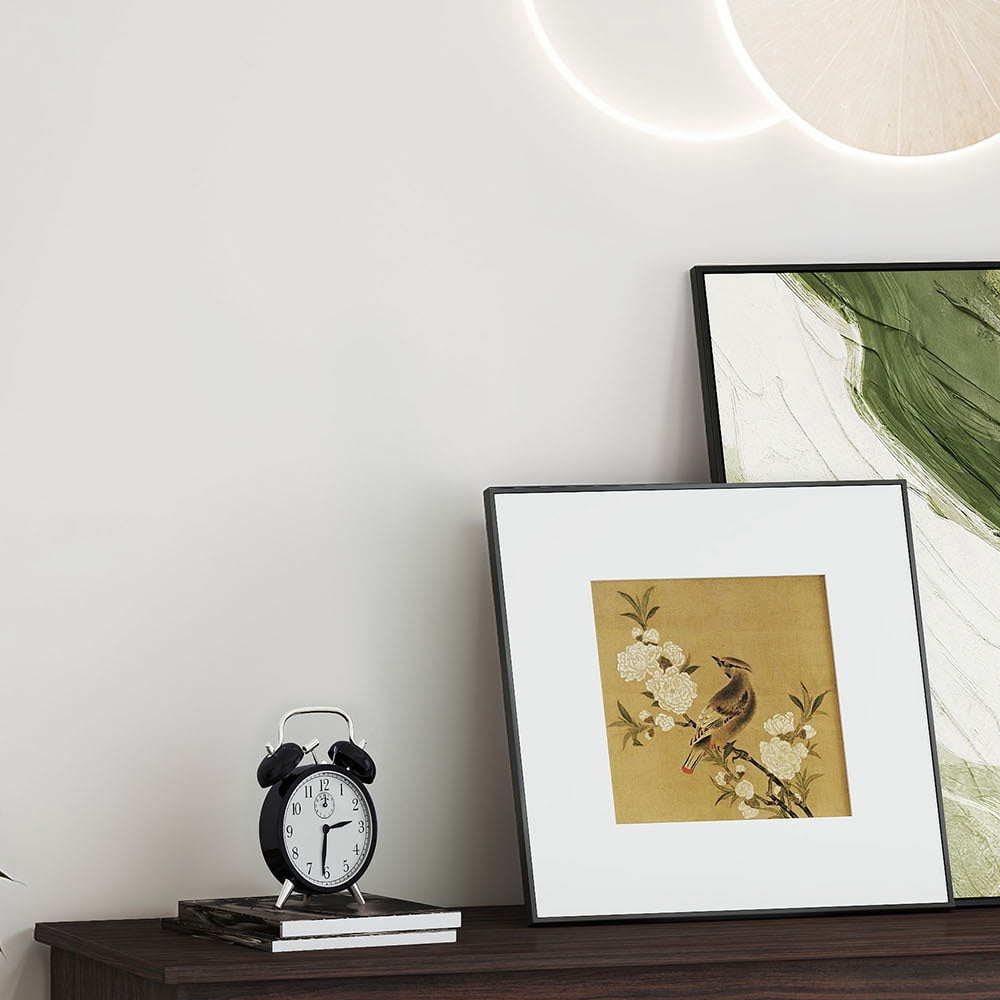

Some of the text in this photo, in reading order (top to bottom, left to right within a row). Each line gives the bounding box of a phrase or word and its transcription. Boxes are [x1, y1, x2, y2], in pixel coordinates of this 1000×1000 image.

[320, 778, 330, 792] 12
[340, 784, 343, 796] 1
[304, 786, 312, 798] 11
[292, 802, 302, 816] 10
[352, 798, 359, 811] 2
[286, 825, 293, 838] 9
[358, 820, 365, 834] 3
[292, 846, 299, 860] 8
[352, 844, 360, 856] 4
[306, 862, 312, 875] 7
[343, 860, 350, 872] 5
[324, 866, 330, 880] 6
